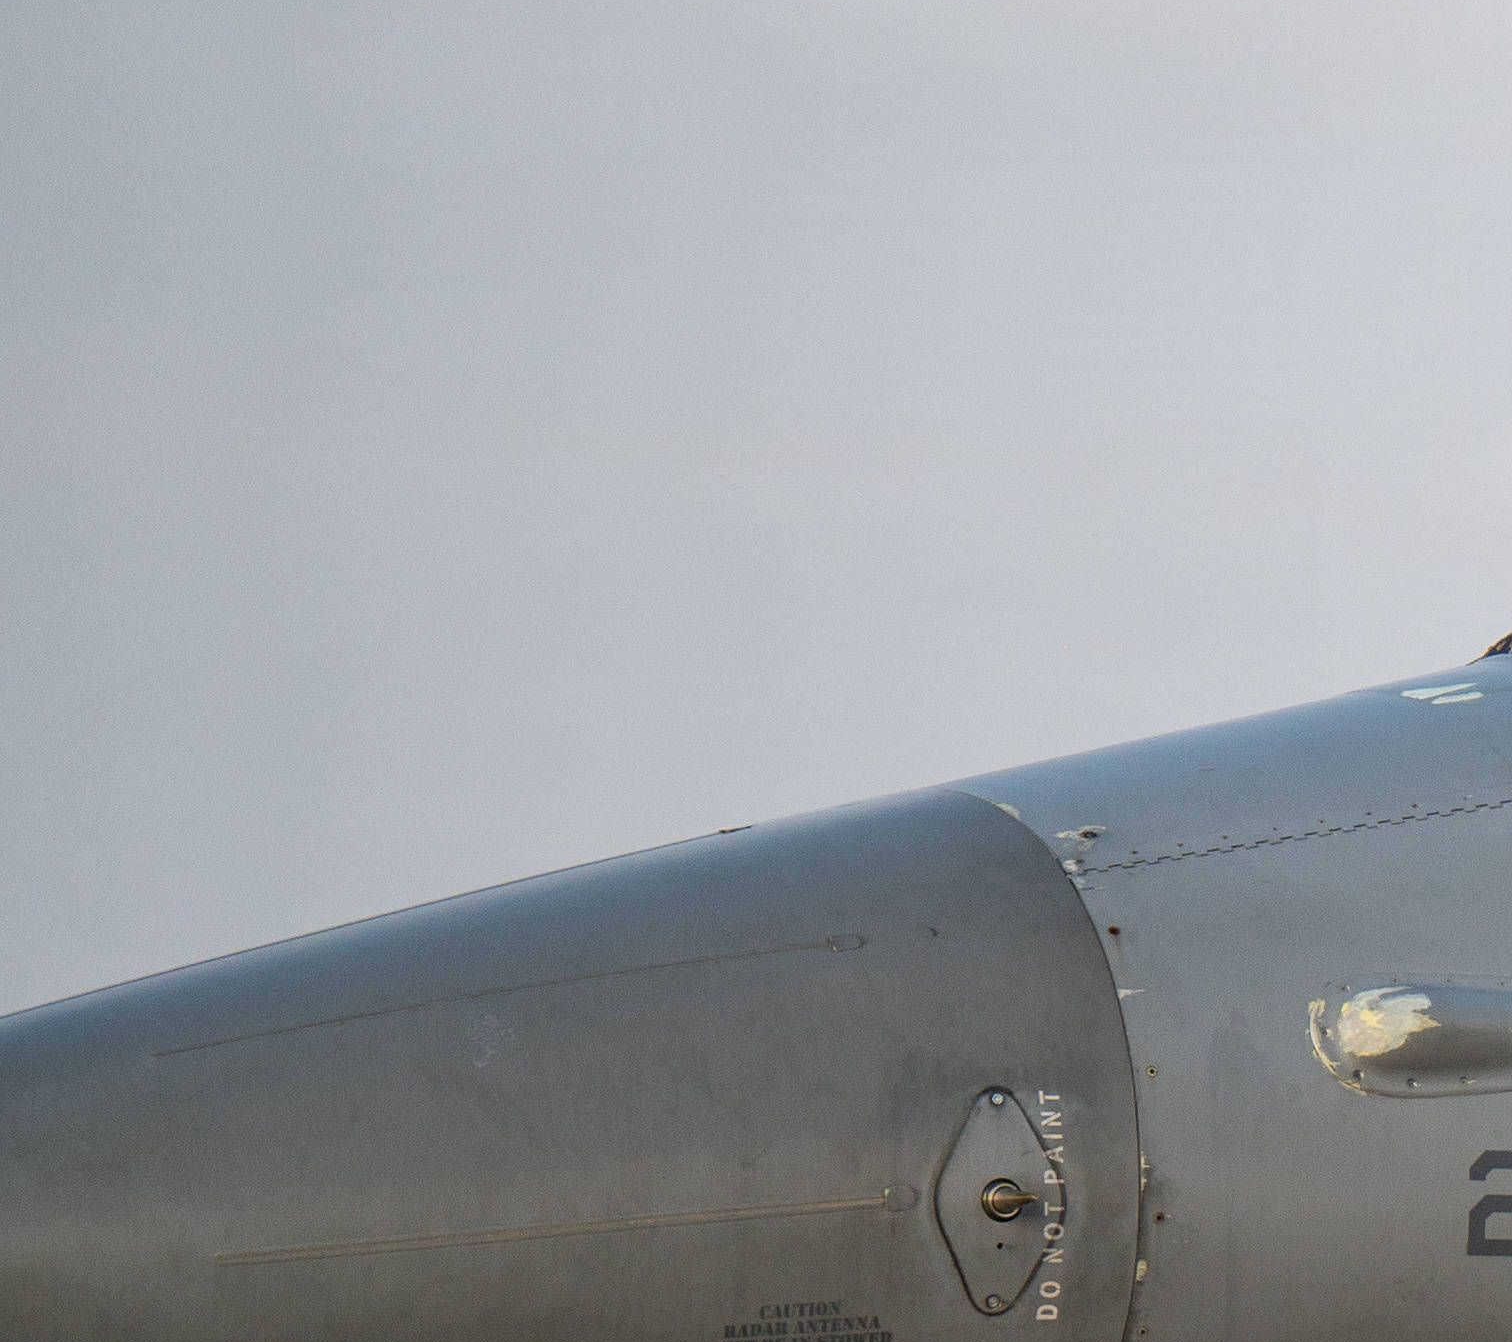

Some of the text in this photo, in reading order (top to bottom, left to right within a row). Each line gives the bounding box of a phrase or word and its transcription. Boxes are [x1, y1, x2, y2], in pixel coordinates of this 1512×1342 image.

[1036, 1090, 1065, 1321] DO NOT PAINT
[758, 1301, 842, 1320] CAUTION
[724, 1316, 881, 1338] RADAR ANTENNA
